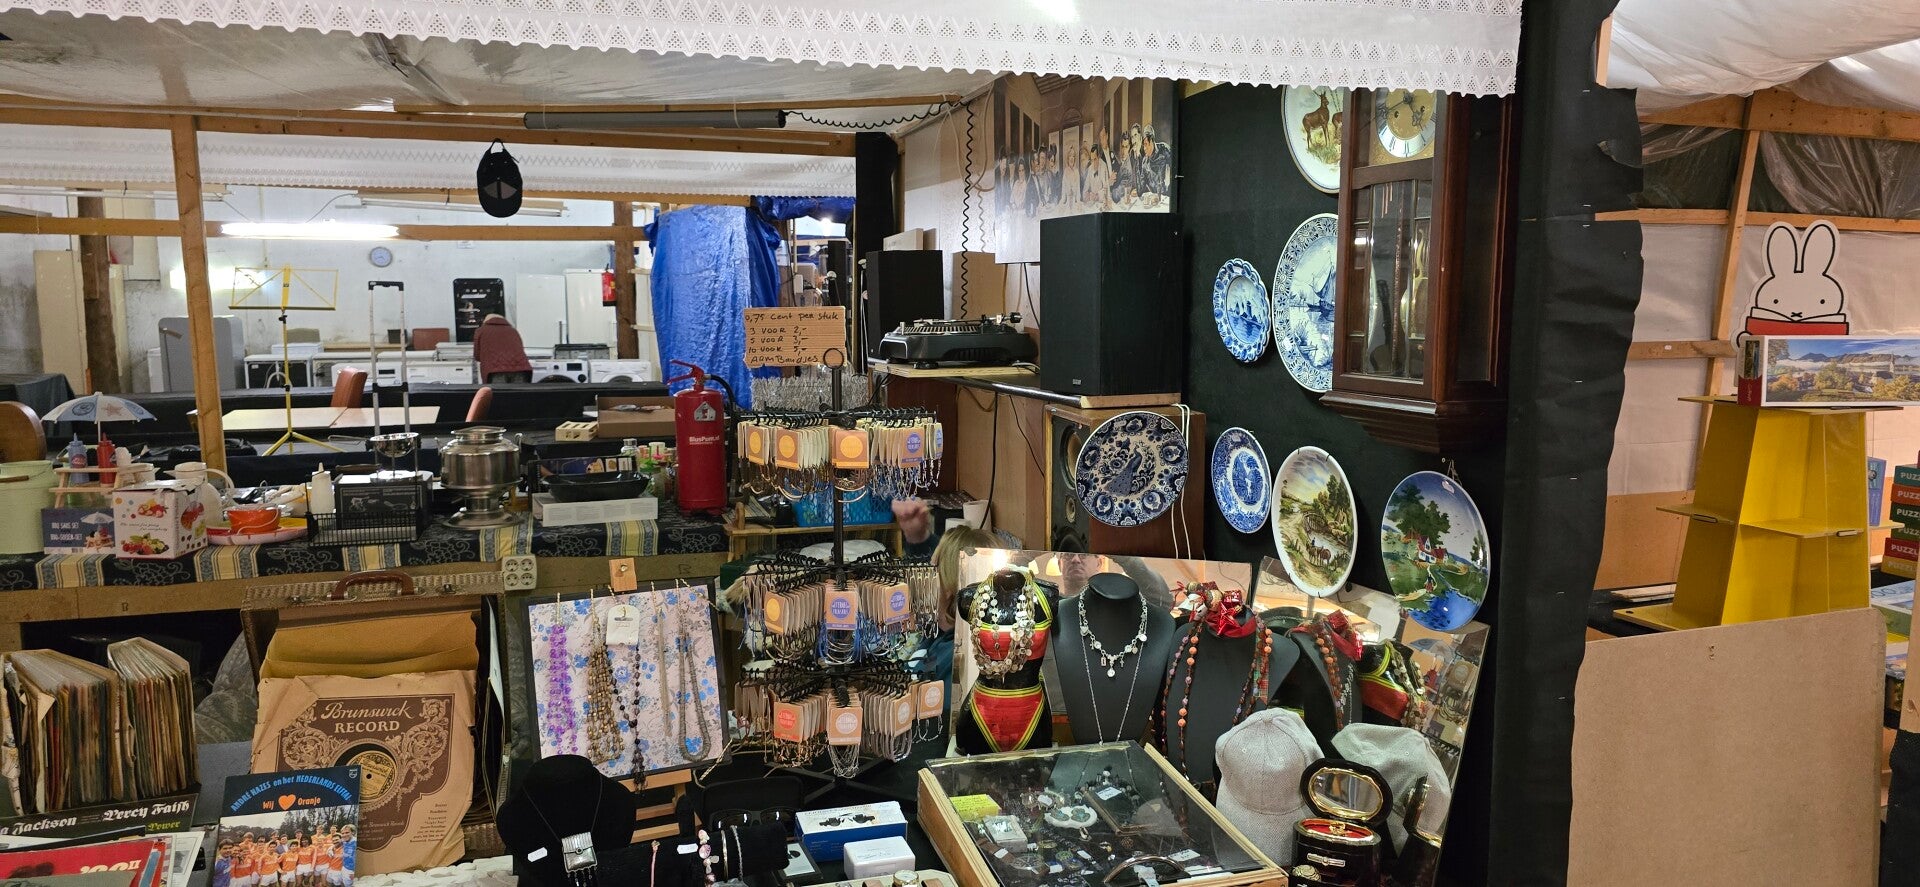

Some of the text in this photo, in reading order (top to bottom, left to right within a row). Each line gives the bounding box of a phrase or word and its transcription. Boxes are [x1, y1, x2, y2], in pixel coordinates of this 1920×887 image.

[750, 327, 756, 335] 3
[320, 699, 415, 720] Brunswick
[334, 720, 400, 734] RECORD
[250, 780, 271, 796] HAZES
[282, 776, 294, 784] het
[296, 774, 336, 789] NEDERLANDS
[334, 783, 353, 801] ELFTAL
[262, 796, 321, 810] Wij Oranje
[102, 807, 149, 821] Percy
[12, 816, 77, 835] Jackson
